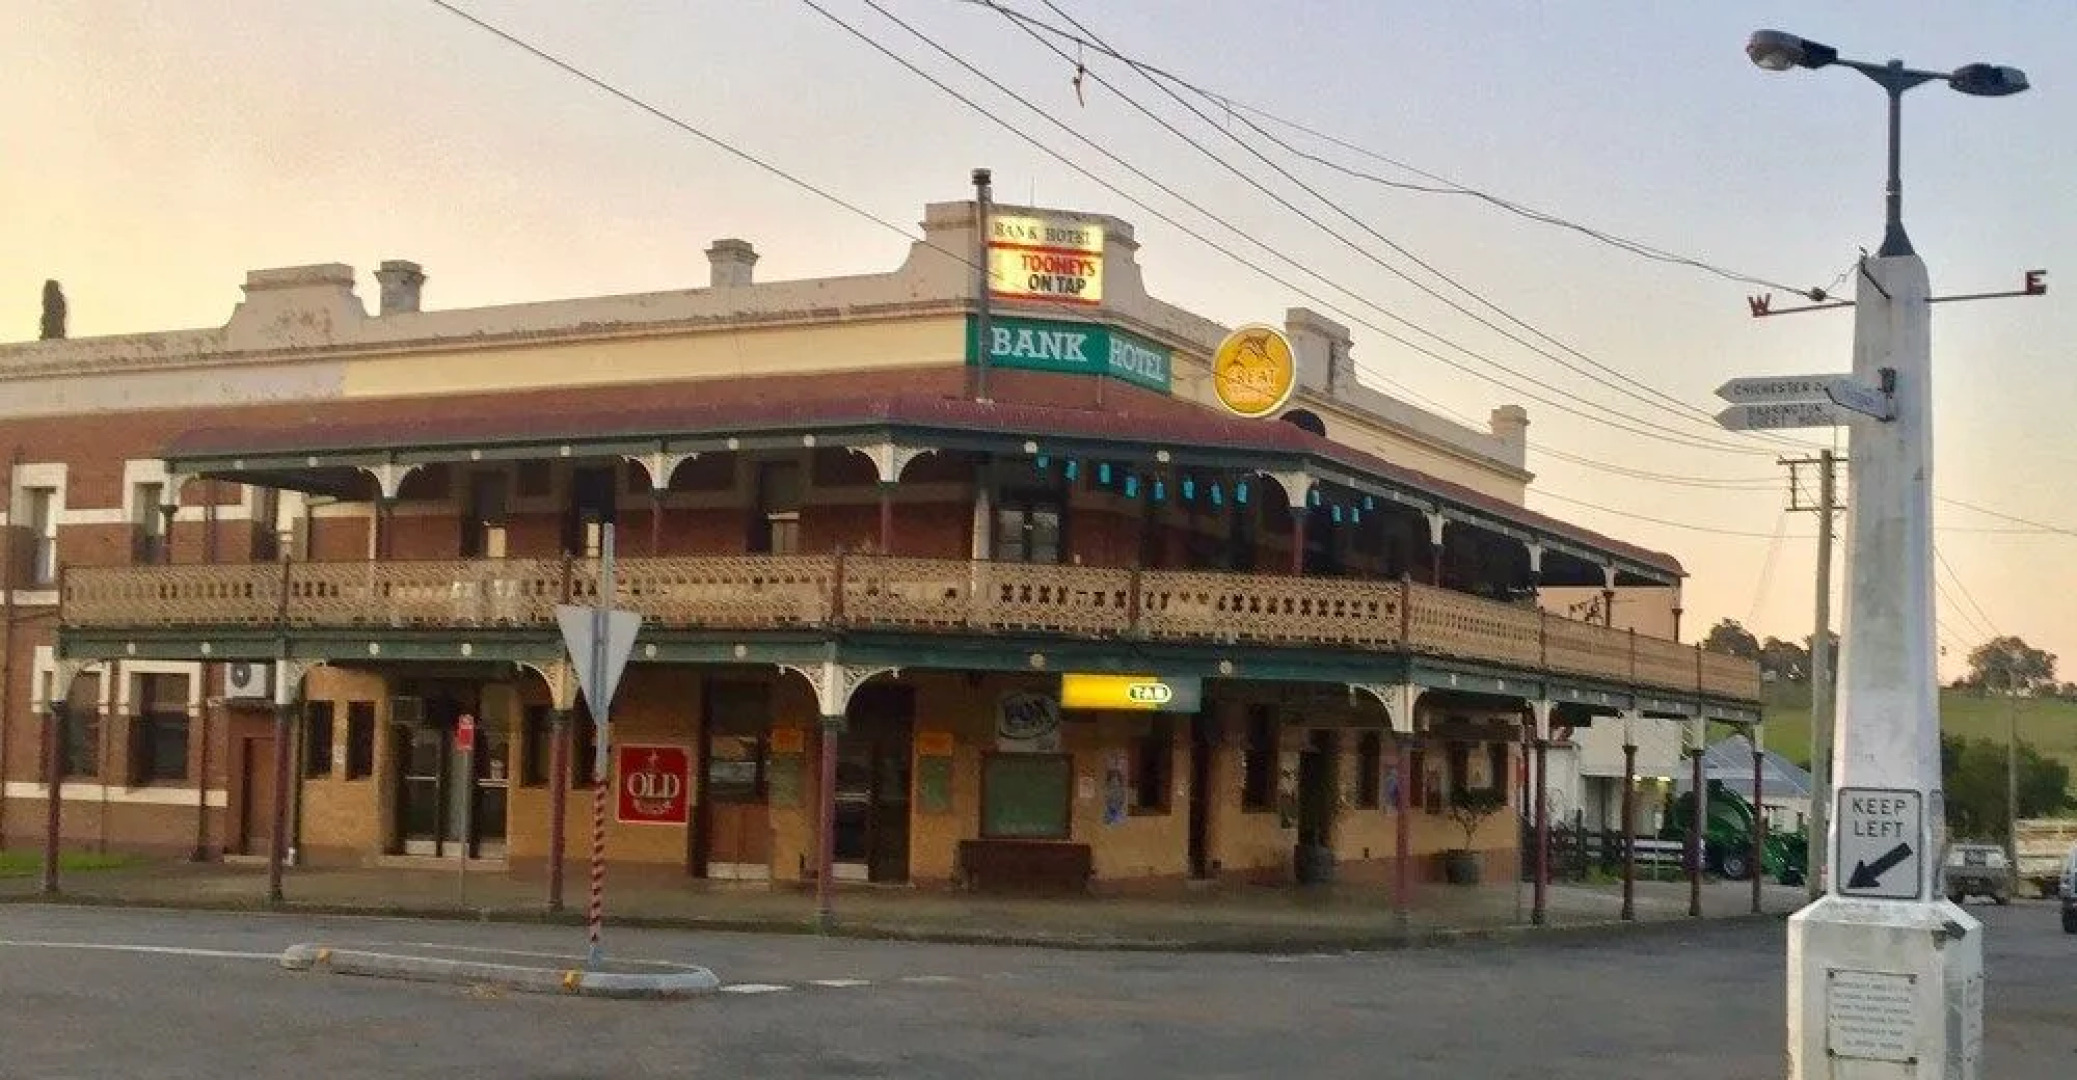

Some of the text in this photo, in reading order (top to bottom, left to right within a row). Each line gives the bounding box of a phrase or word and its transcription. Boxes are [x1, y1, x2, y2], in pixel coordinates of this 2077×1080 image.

[993, 220, 1091, 246] BANK HOTEL
[1028, 273, 1087, 294] ON TAP
[2025, 269, 2047, 295] E
[1749, 293, 1772, 318] W
[990, 326, 1166, 382] BANK HOTEL
[1733, 382, 1810, 396] CHICHESTER
[626, 772, 681, 799] OLD
[1852, 797, 1907, 816] KEEP
[1853, 820, 1905, 838] LEFT
